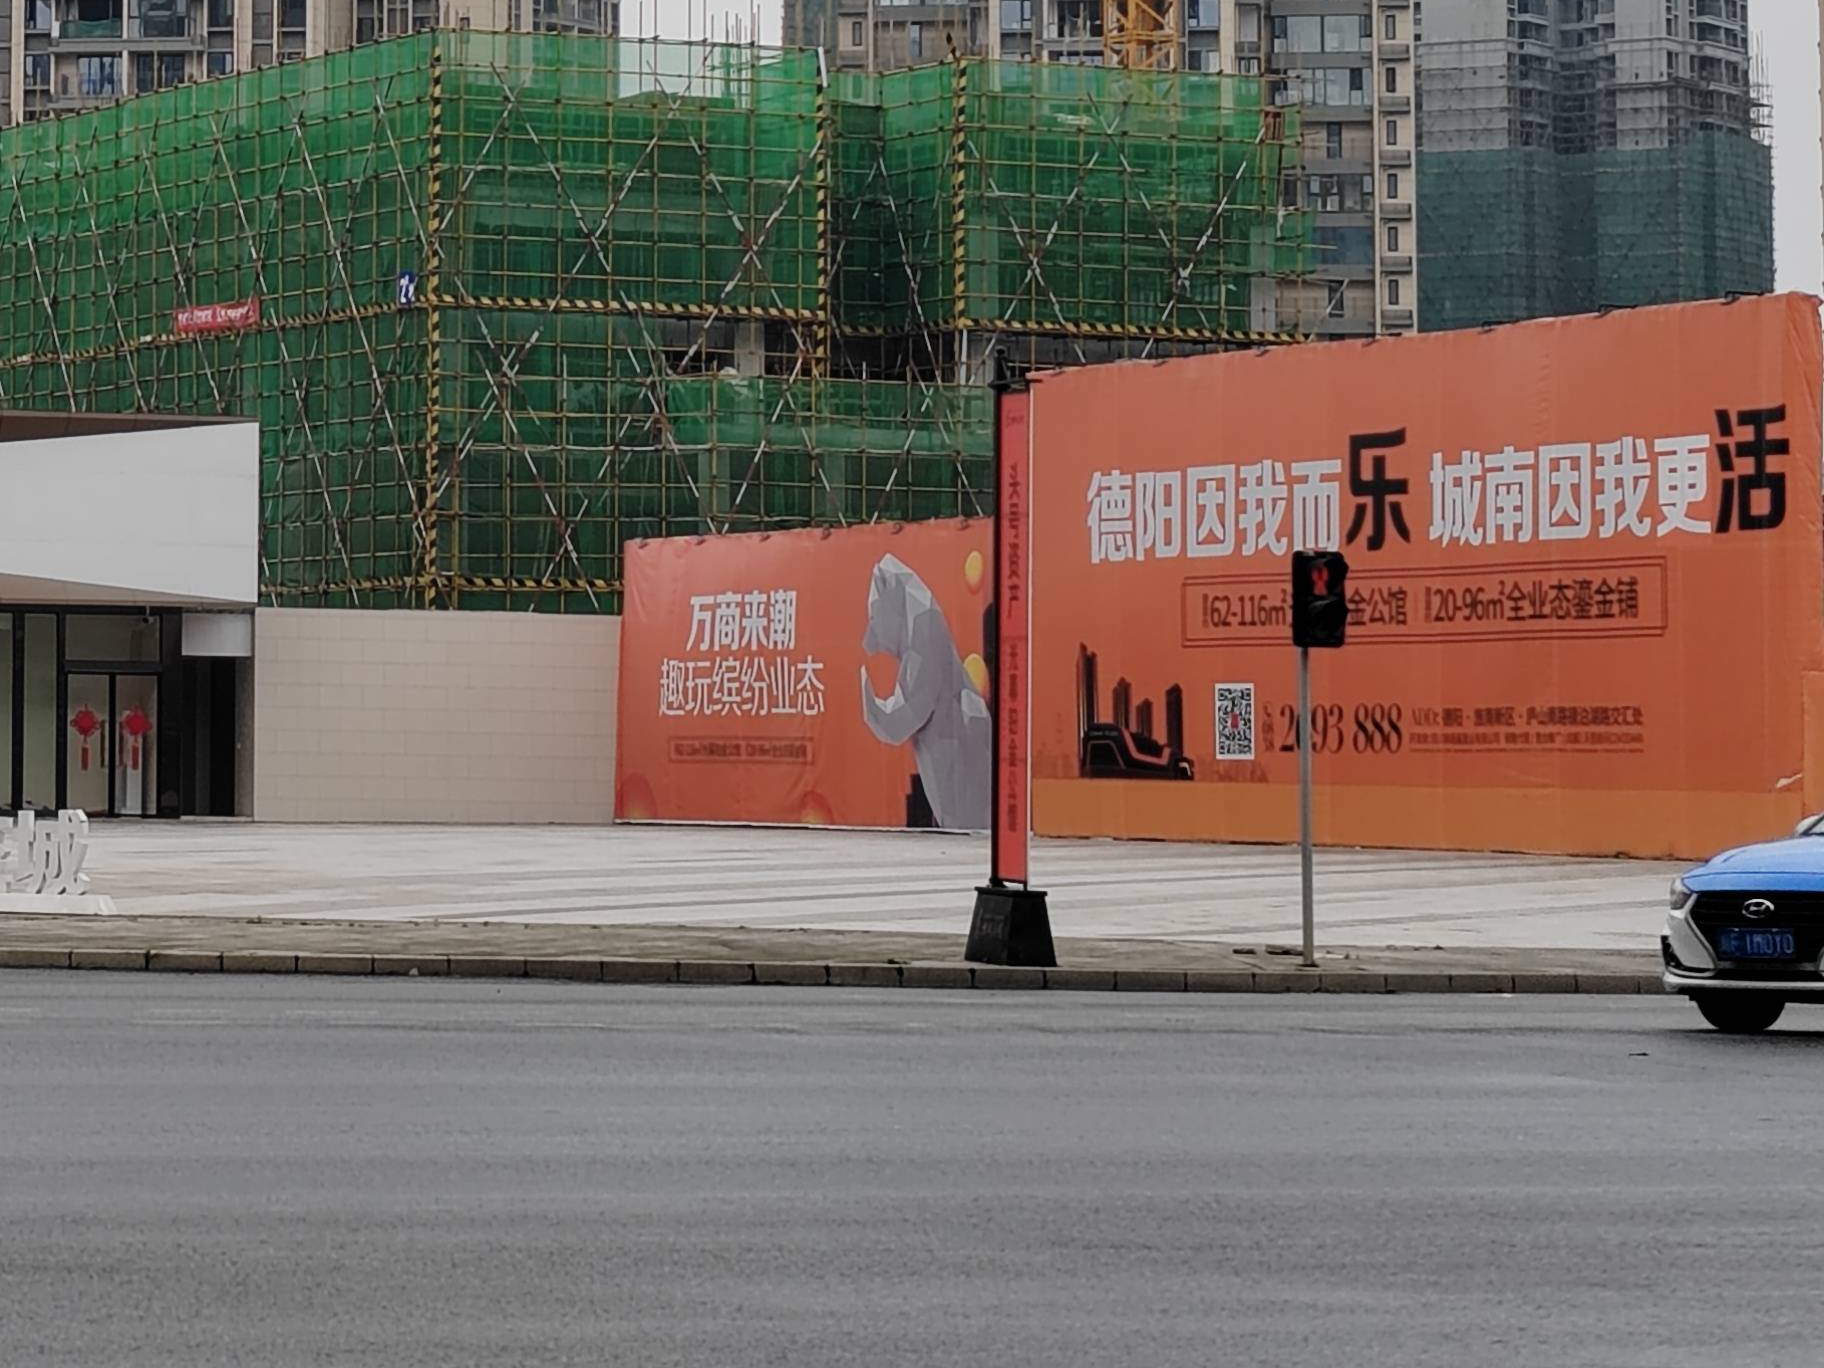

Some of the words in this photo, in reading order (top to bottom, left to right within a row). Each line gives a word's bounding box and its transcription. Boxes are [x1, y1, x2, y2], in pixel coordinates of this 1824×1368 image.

[1087, 427, 1411, 564] 德阳因我而乐
[1429, 403, 1790, 549] 城南因我更活
[686, 589, 797, 651] 万商来潮
[658, 655, 825, 716] 趣玩缤纷业态
[1352, 702, 1403, 754] 888
